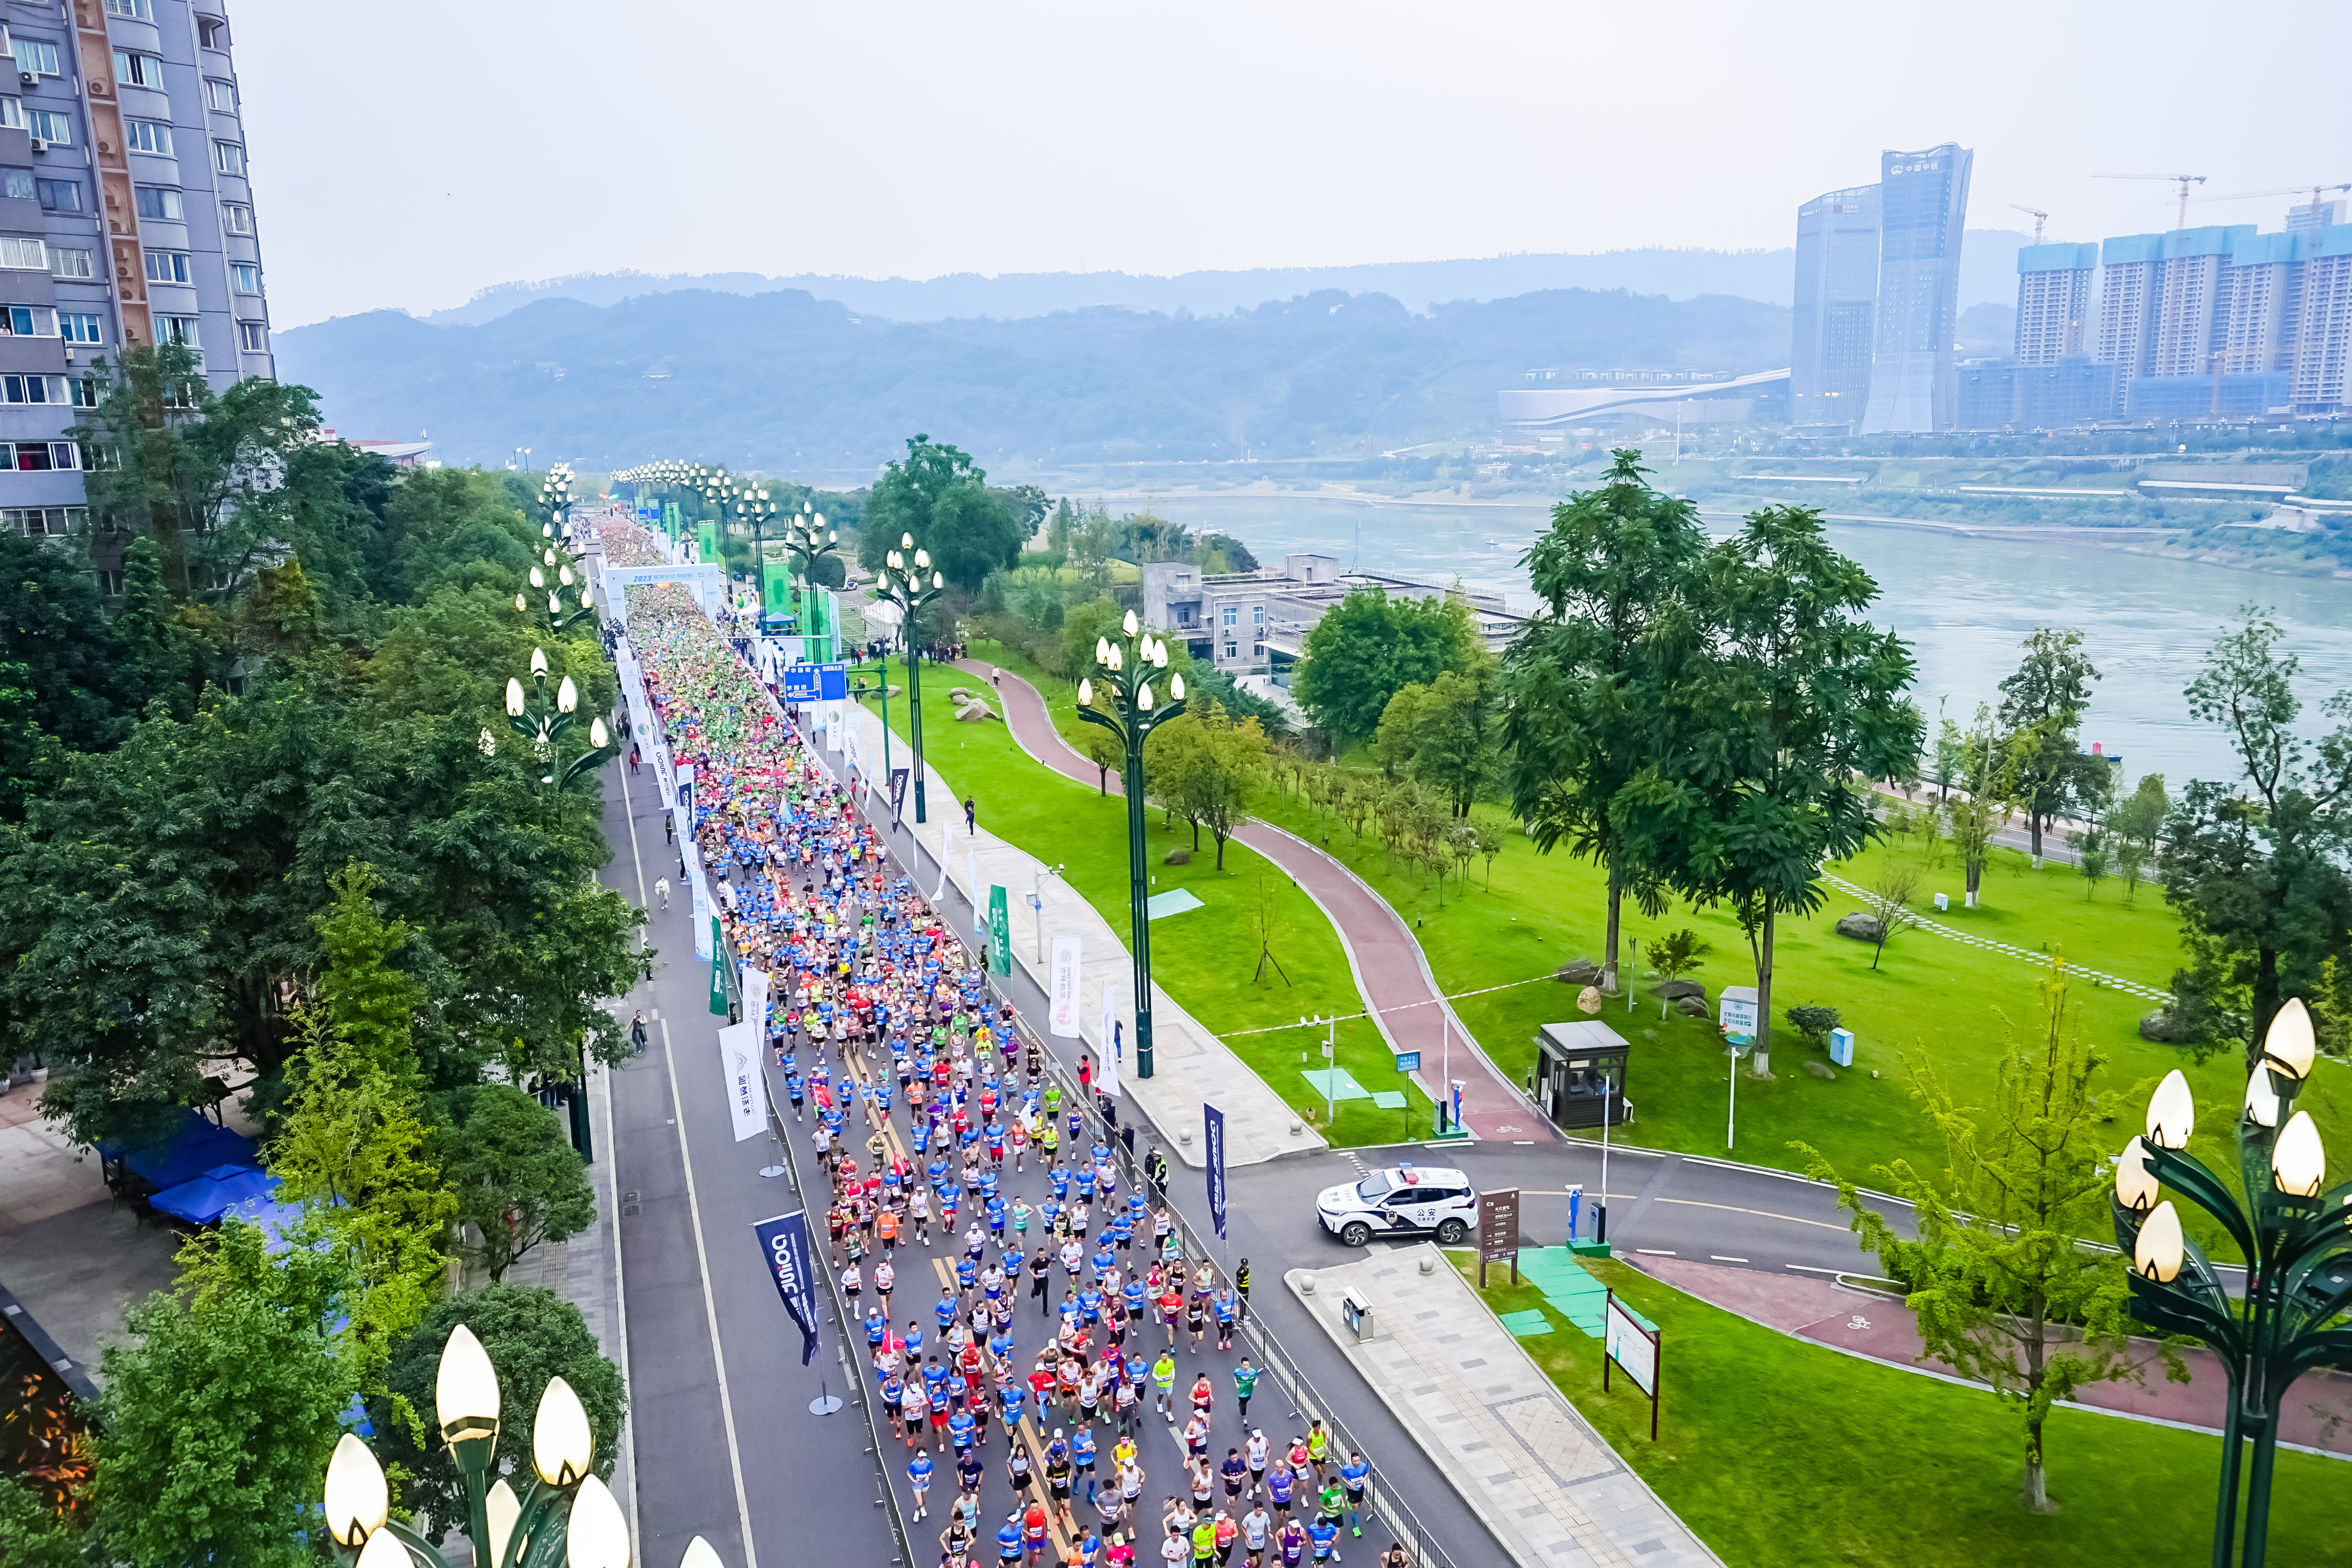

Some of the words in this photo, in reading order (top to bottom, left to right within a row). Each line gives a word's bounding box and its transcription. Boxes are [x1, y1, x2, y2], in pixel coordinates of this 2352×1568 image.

[1906, 162, 1939, 173] 中国中铁
[1417, 1208, 1436, 1217] 公安
